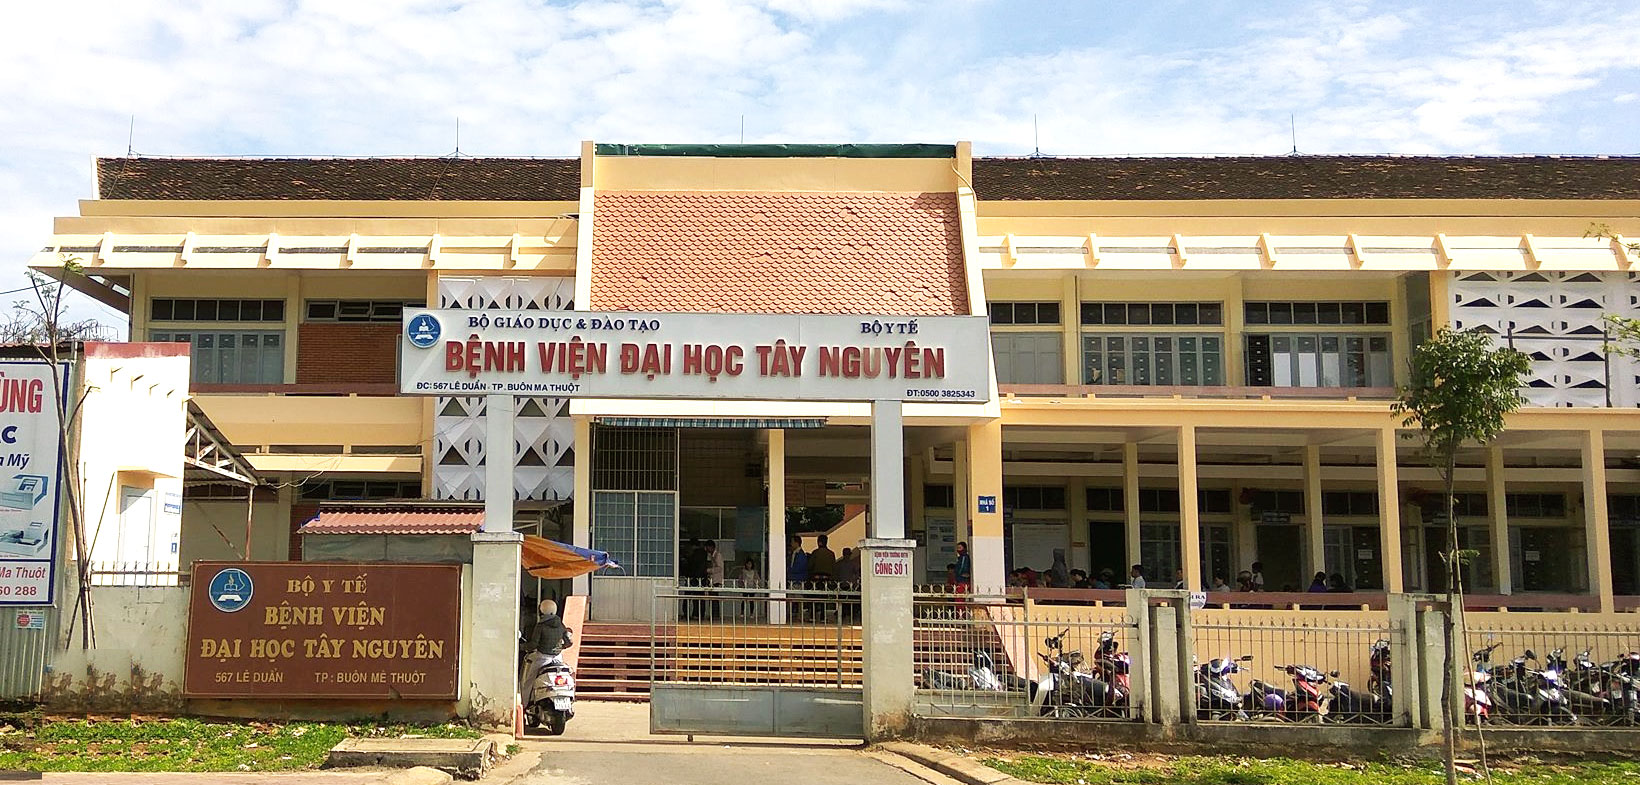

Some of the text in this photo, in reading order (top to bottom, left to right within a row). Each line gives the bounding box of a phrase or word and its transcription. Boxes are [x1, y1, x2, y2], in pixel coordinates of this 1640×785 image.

[468, 314, 661, 334] BỘ GIÁO DỤC & ĐÀO TẠO
[860, 319, 919, 336] BỘ Y TẾ
[445, 334, 945, 383] BỆNH VIỆN ĐẠI HỌC TÂY NGUYÊN
[433, 382, 449, 390] 567
[449, 381, 460, 390] LÊ
[462, 379, 487, 390] DUẨN
[507, 382, 533, 391] BUÔN
[534, 384, 548, 392] MA
[550, 382, 580, 393] THUỘT
[941, 390, 976, 398] 3825343
[7, 453, 30, 470] Mỹ
[15, 566, 46, 581] Thuột
[875, 558, 908, 575] CỔNG SỐ 1
[15, 586, 37, 596] 288
[286, 573, 368, 597] BỘ Y TẾ
[264, 601, 386, 631] BỆNH VIỆN
[200, 633, 445, 663] ĐẠI HỌC TÂY NGUYÊN
[215, 672, 234, 683] 567
[236, 670, 250, 683] LÊ
[252, 668, 284, 683] DUẨN
[336, 669, 367, 684] BUÔN
[370, 670, 387, 684] MÊ
[390, 670, 427, 686] THUỘT
